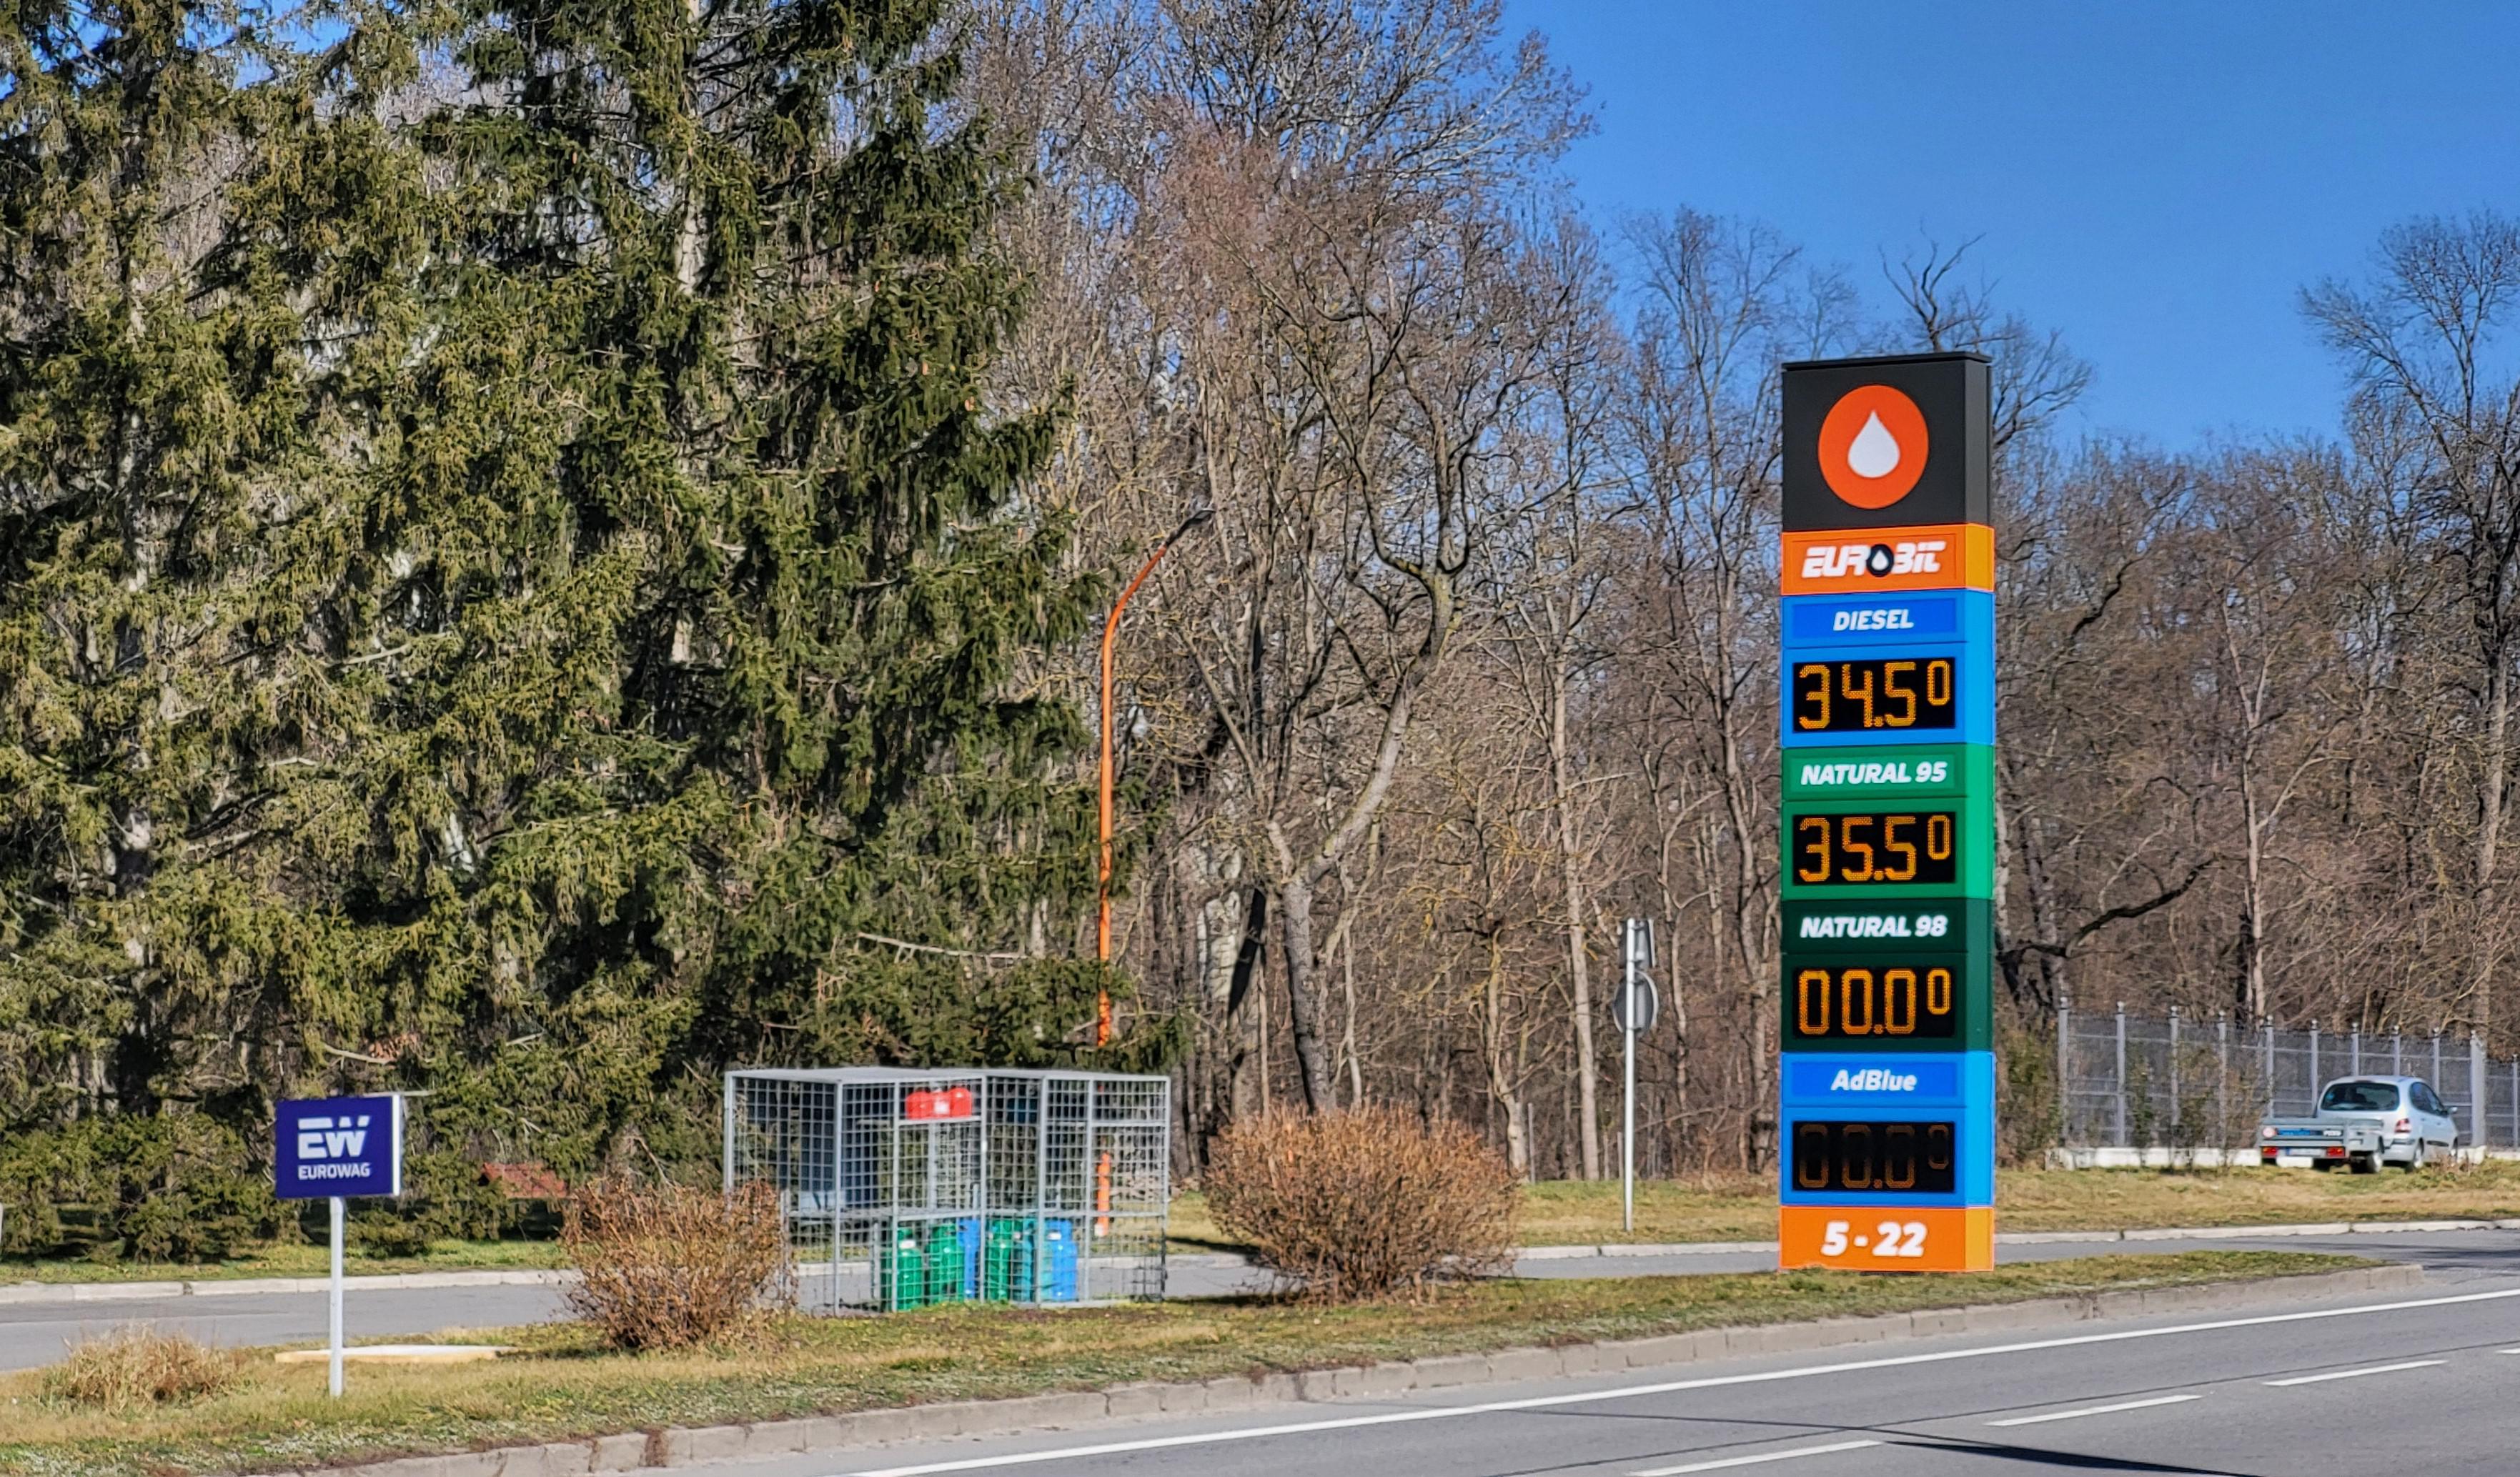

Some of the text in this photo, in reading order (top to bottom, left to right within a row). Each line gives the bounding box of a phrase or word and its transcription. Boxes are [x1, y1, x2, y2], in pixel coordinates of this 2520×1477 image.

[1834, 609, 1914, 631] DIESEL
[1800, 761, 1948, 785] NATURAL 95
[1800, 915, 1948, 938] NATURAL 98
[1830, 1069, 1918, 1091] AdBlue
[298, 1115, 370, 1159] EW
[298, 1163, 370, 1180] EUROWAG
